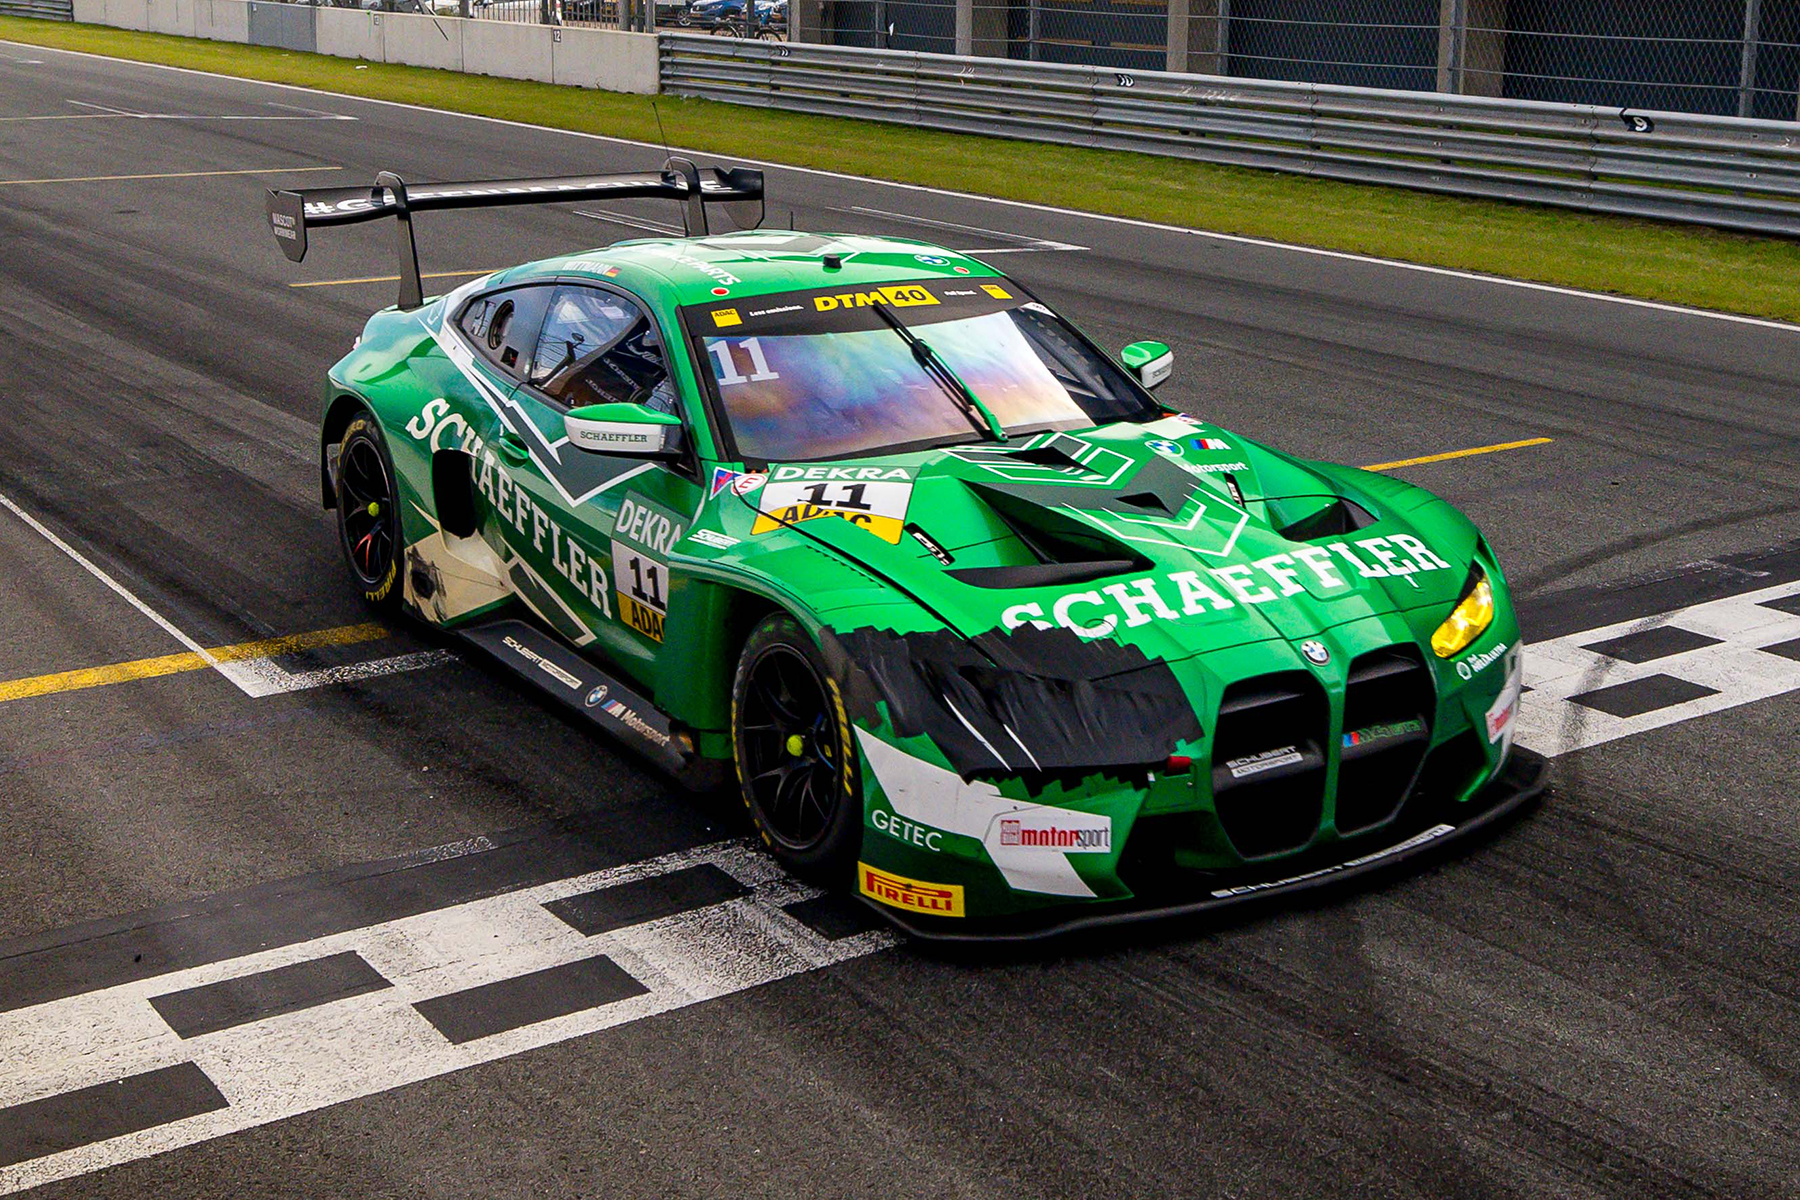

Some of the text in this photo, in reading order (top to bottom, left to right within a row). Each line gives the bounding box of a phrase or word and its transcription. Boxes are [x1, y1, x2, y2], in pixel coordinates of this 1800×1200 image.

[553, 30, 561, 42] 12
[1632, 116, 1648, 132] 9
[714, 309, 736, 318] ADAC
[813, 289, 927, 312] DTM 40
[707, 337, 780, 386] 11
[580, 430, 648, 443] SCHAEFFLER
[773, 466, 912, 481] DEKRA
[797, 483, 872, 511] 11
[615, 498, 682, 556] DEKRA
[629, 556, 666, 612] 11
[1000, 533, 1452, 639] SCHAEFFLER
[630, 600, 665, 641] ADA
[620, 709, 671, 747] Motorsport
[871, 809, 943, 852] GETEC
[1021, 826, 1110, 850] motorsport
[866, 870, 953, 912] PIRELLI
